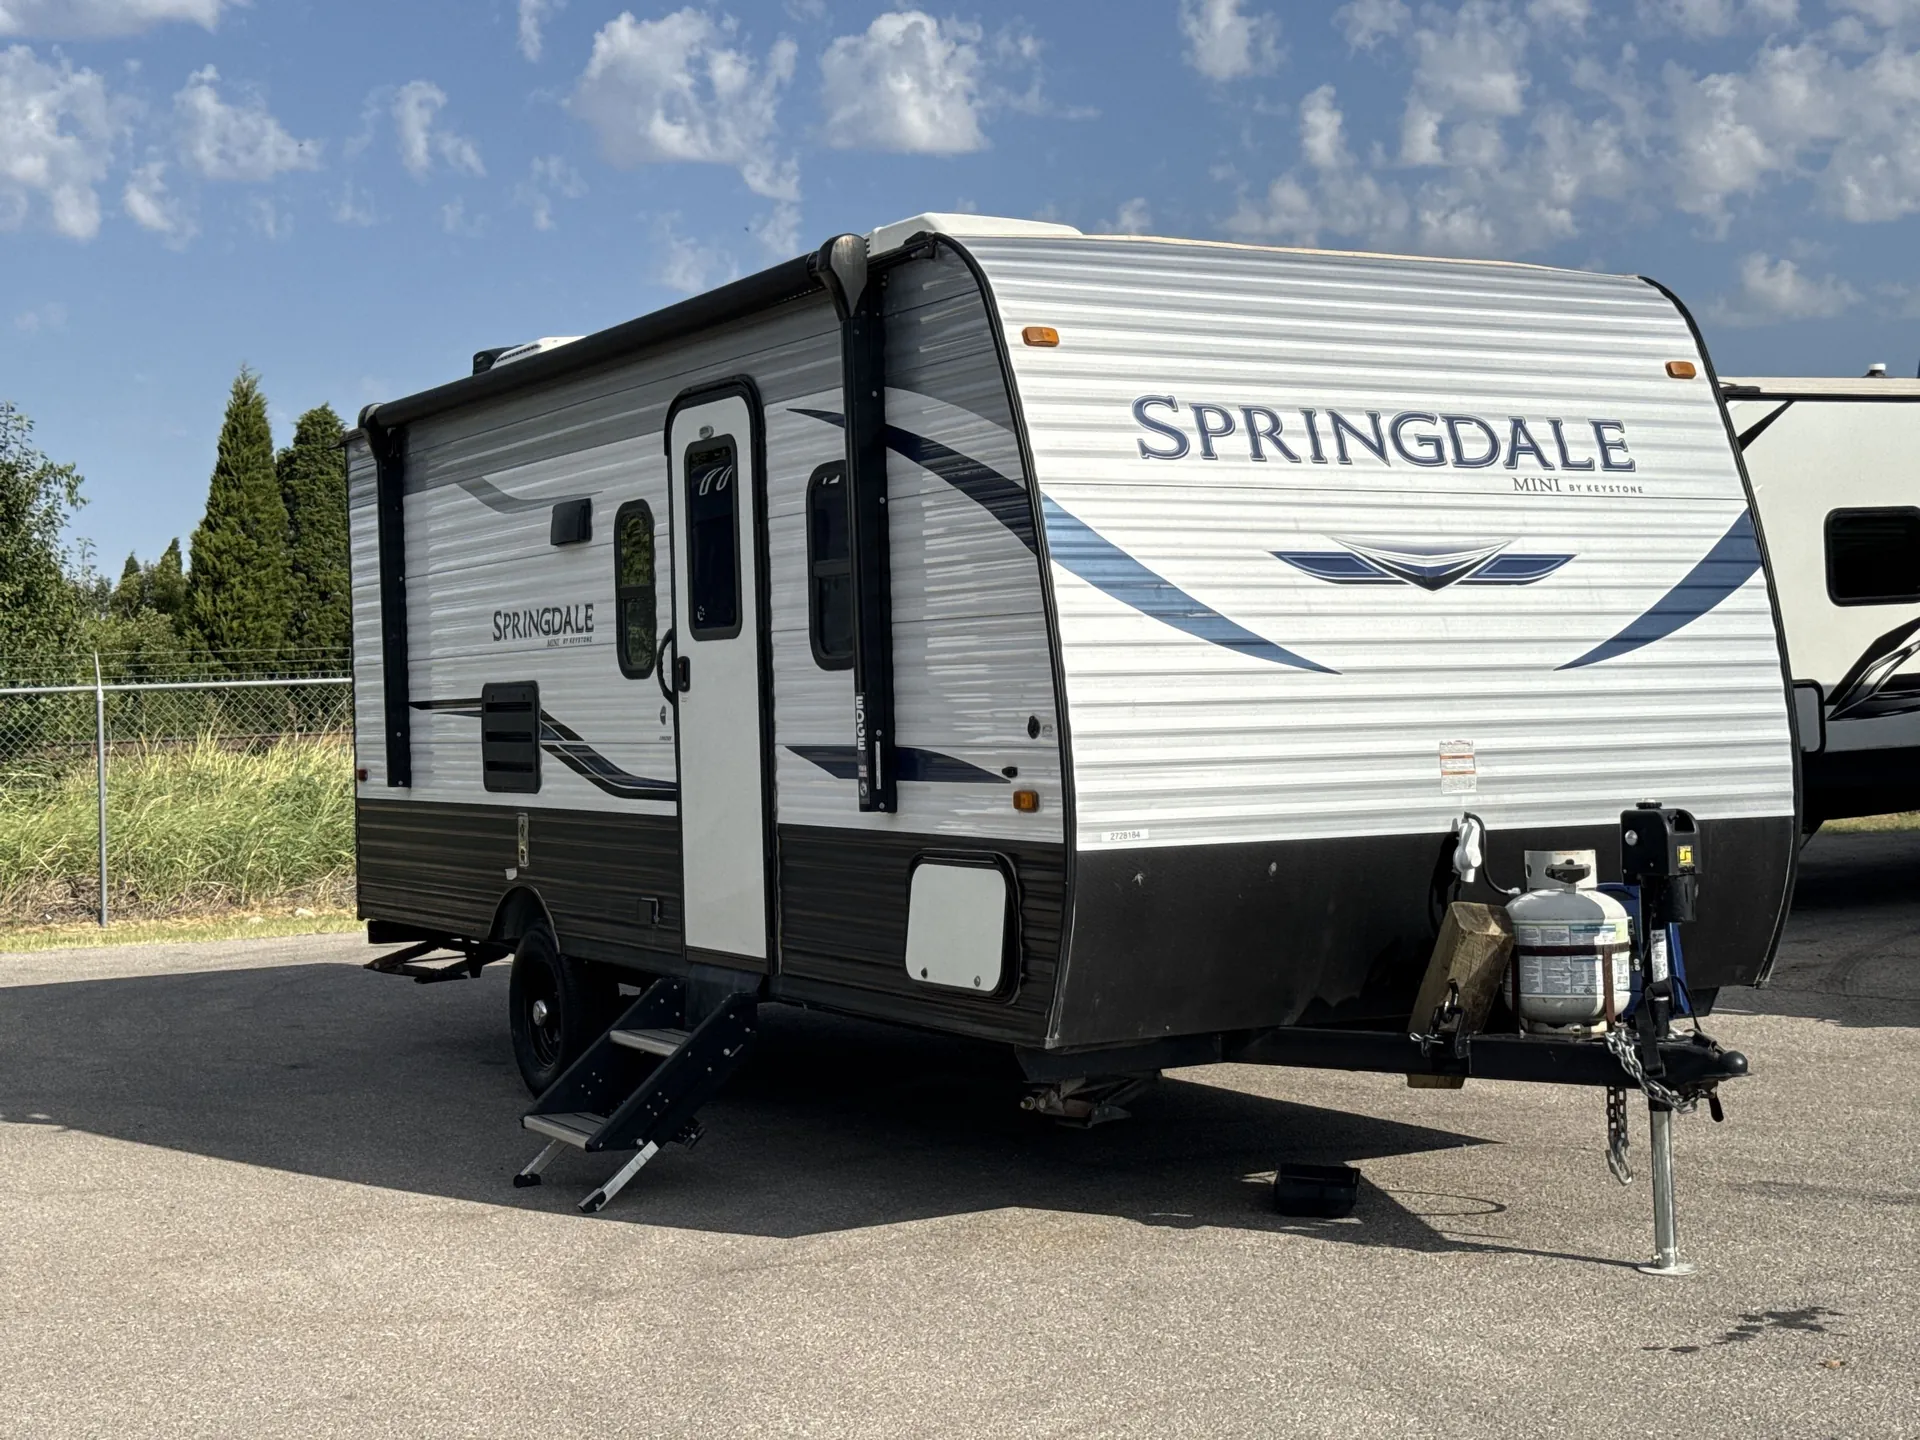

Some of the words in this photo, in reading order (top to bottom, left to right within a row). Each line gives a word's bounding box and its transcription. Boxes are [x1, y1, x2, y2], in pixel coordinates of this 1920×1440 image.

[1131, 394, 1637, 473] SPRINGDALE
[1511, 477, 1562, 493] MINI
[1568, 483, 1582, 492] BY
[1586, 484, 1644, 494] KEYSTONE
[492, 603, 594, 641] SPRINGDALE
[856, 695, 866, 750] EDGE
